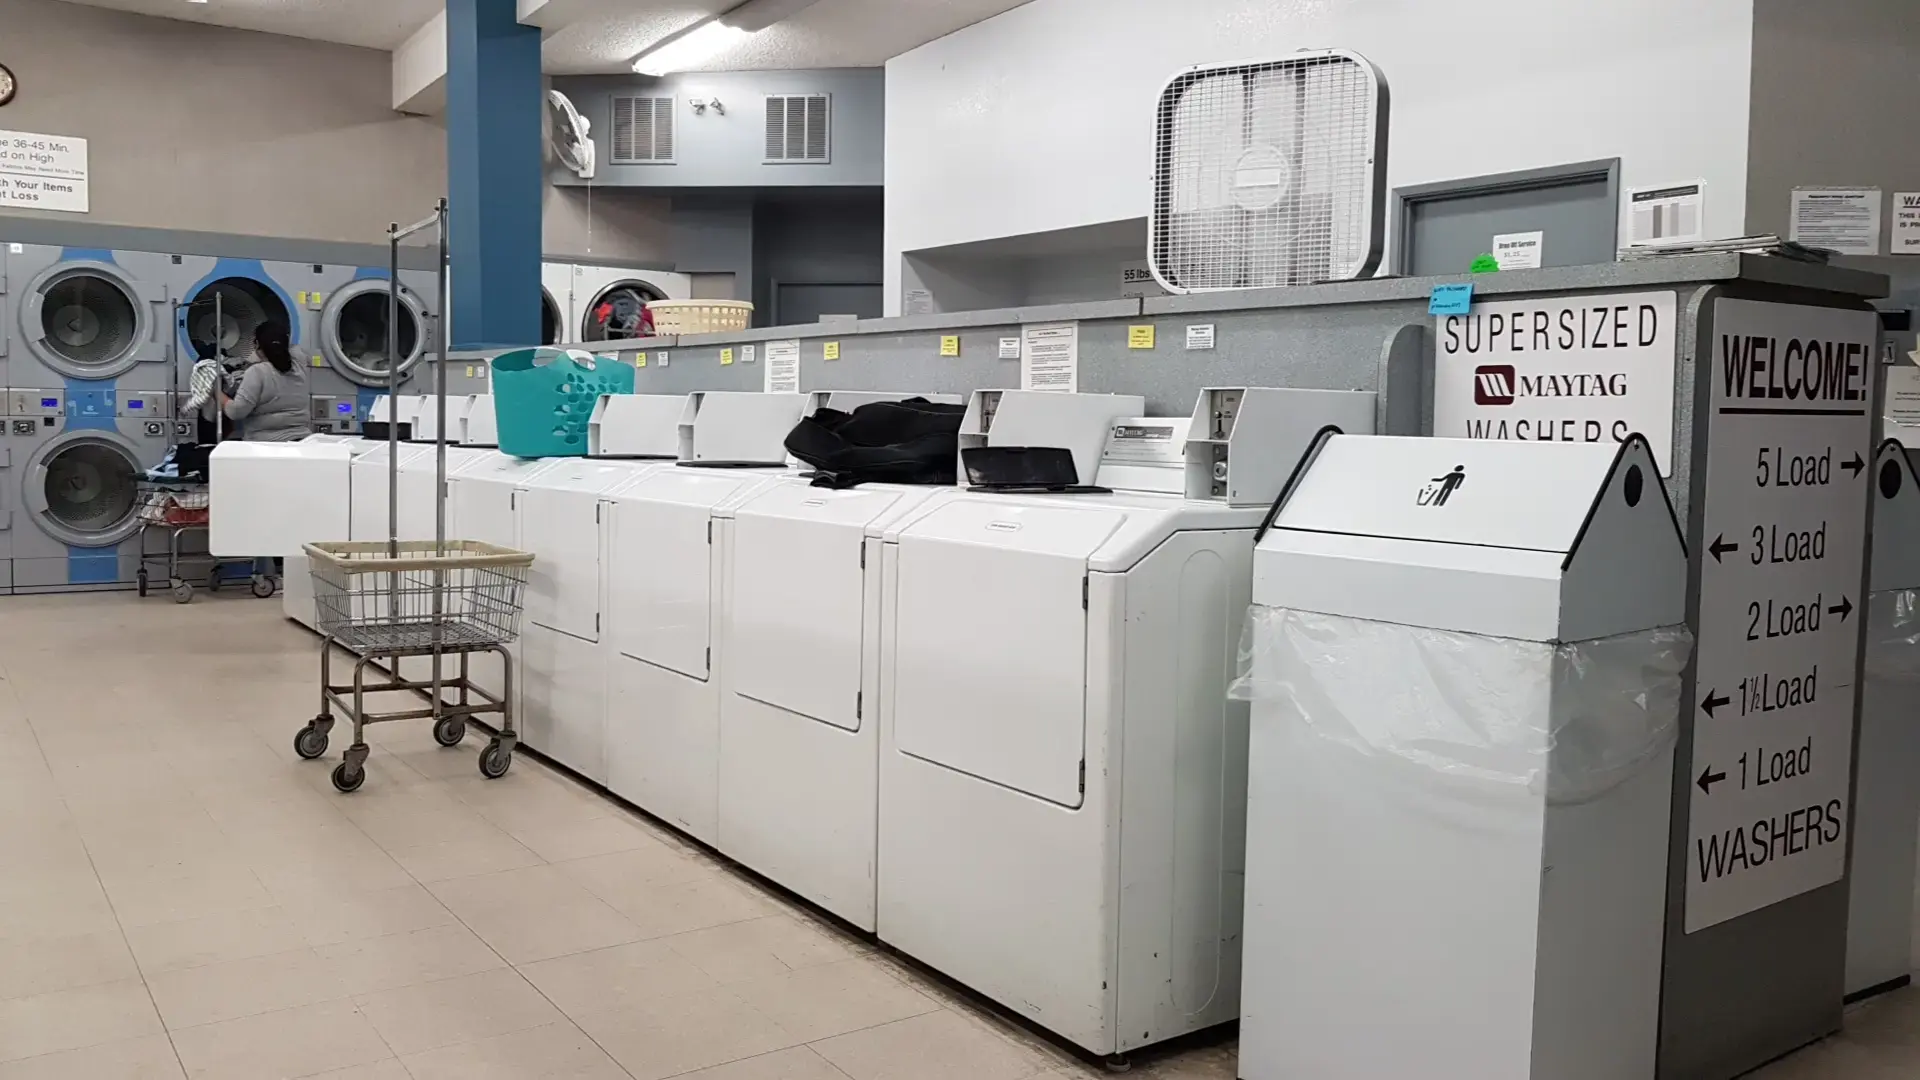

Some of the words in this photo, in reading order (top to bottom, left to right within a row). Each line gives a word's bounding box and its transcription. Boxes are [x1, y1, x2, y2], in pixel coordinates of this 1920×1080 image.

[11, 152, 25, 160] on
[29, 152, 54, 164] High
[13, 139, 45, 150] 36-45
[11, 190, 39, 201] Loss
[14, 179, 38, 189] Your
[43, 182, 73, 193] Items
[1124, 269, 1135, 280] 55
[1136, 268, 1150, 279] lbs
[1445, 304, 1658, 354] SUPERSIZED
[1520, 373, 1628, 397] MAYTAG
[1722, 334, 1869, 401] WELCOME!
[1756, 447, 1770, 487] 5
[1776, 446, 1831, 487] Load
[1751, 525, 1764, 565] 3
[1770, 520, 1826, 564] Load
[1746, 601, 1761, 641] 2
[1766, 592, 1822, 638] Load
[1762, 665, 1817, 712] Load
[1738, 751, 1747, 790] 1
[1756, 735, 1811, 786] Load
[1697, 799, 1842, 883] WASHERS
